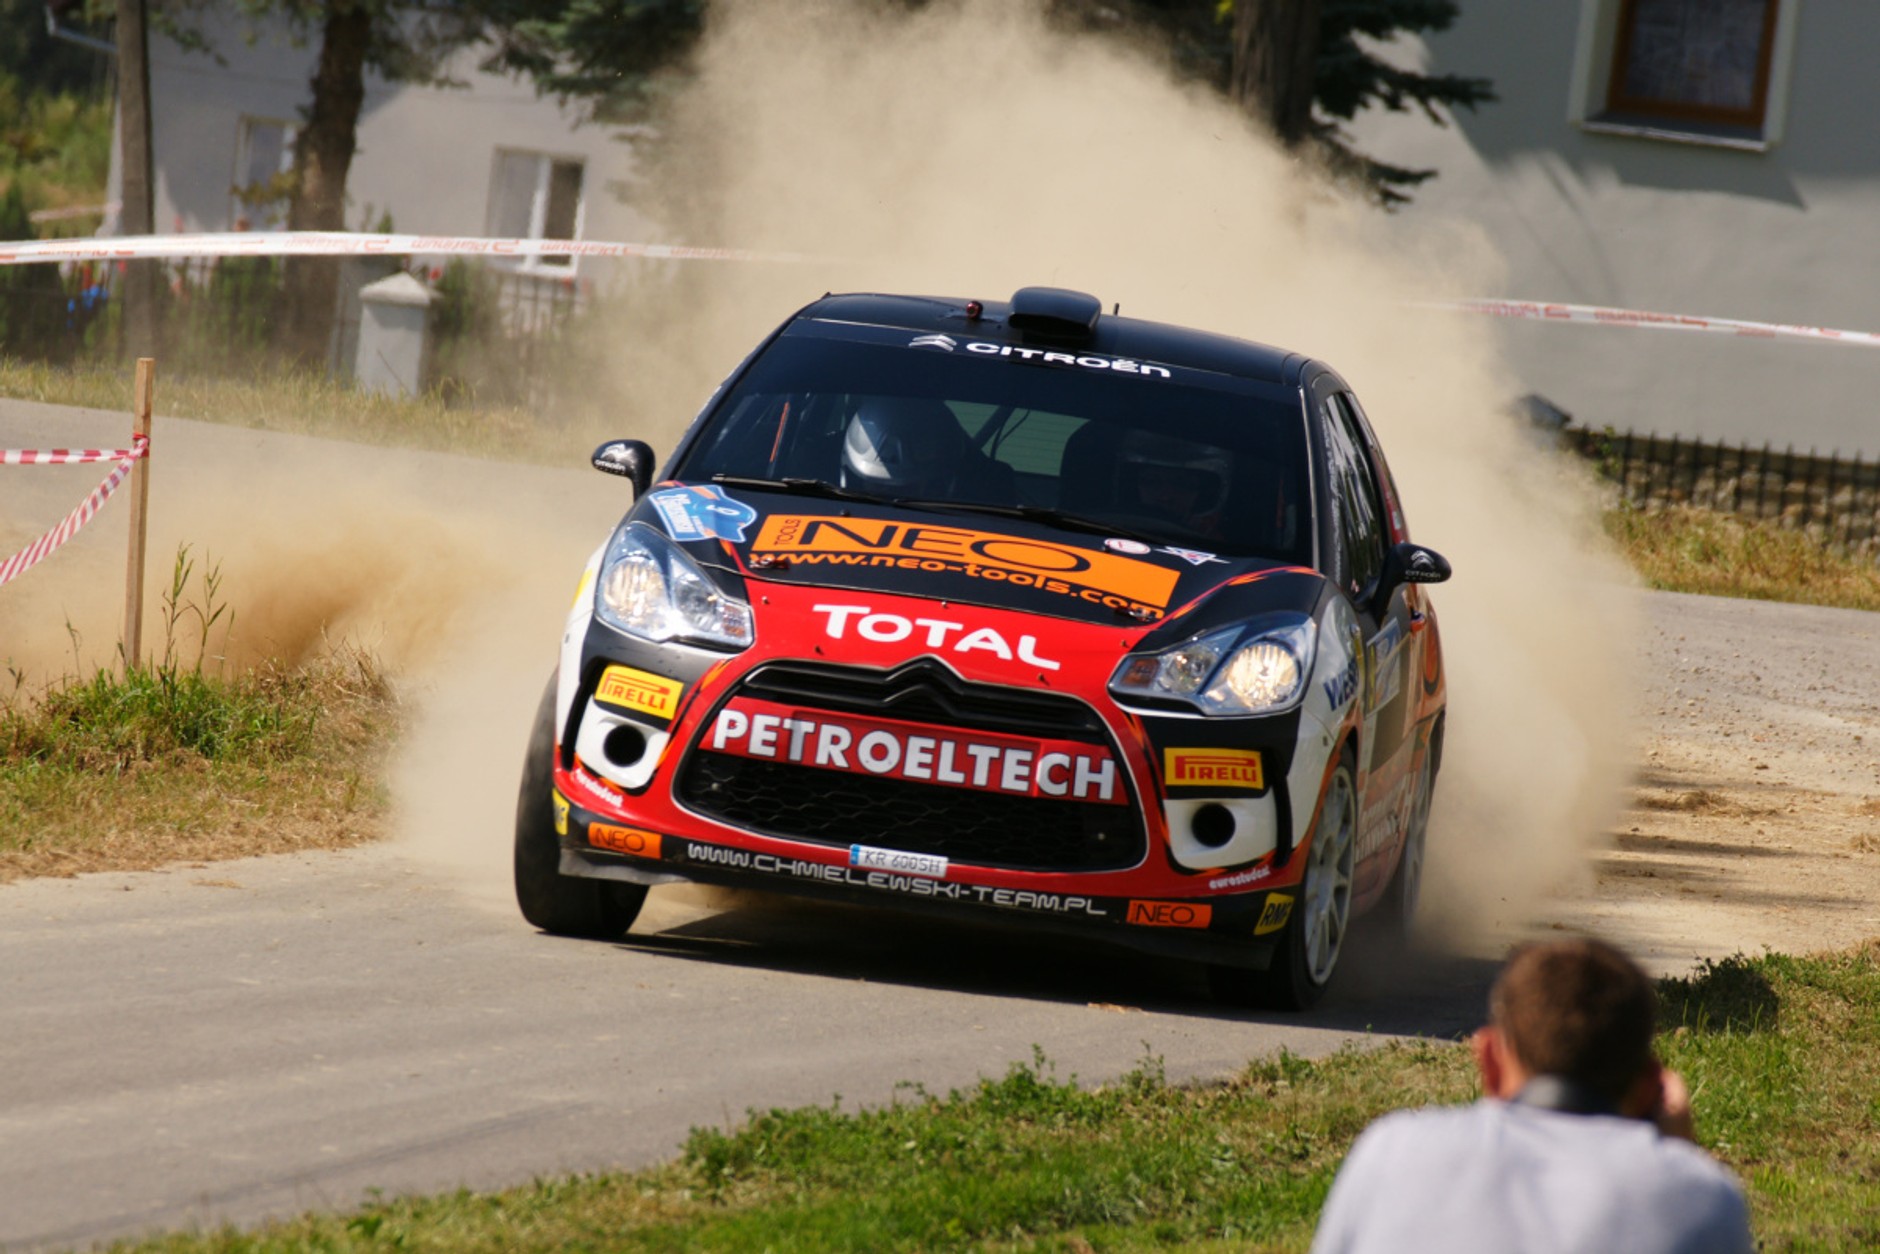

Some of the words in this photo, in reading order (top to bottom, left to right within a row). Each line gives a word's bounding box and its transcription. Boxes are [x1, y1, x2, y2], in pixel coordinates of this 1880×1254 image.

[774, 519, 801, 546] TOOLS
[798, 520, 1091, 572] NEO
[749, 553, 1165, 619] www.neo-tools.com
[813, 603, 1060, 670] TOTAL
[601, 672, 671, 711] PIRELLI
[713, 708, 1116, 800] PETROELTECH
[1175, 756, 1257, 782] PIRELLI
[596, 828, 645, 853] NEO
[687, 843, 1107, 916] WWW.CHMIELEWSKI-TEAM.PL
[864, 850, 887, 866] KR
[891, 854, 941, 873] 600SH
[1135, 903, 1195, 925] NEO
